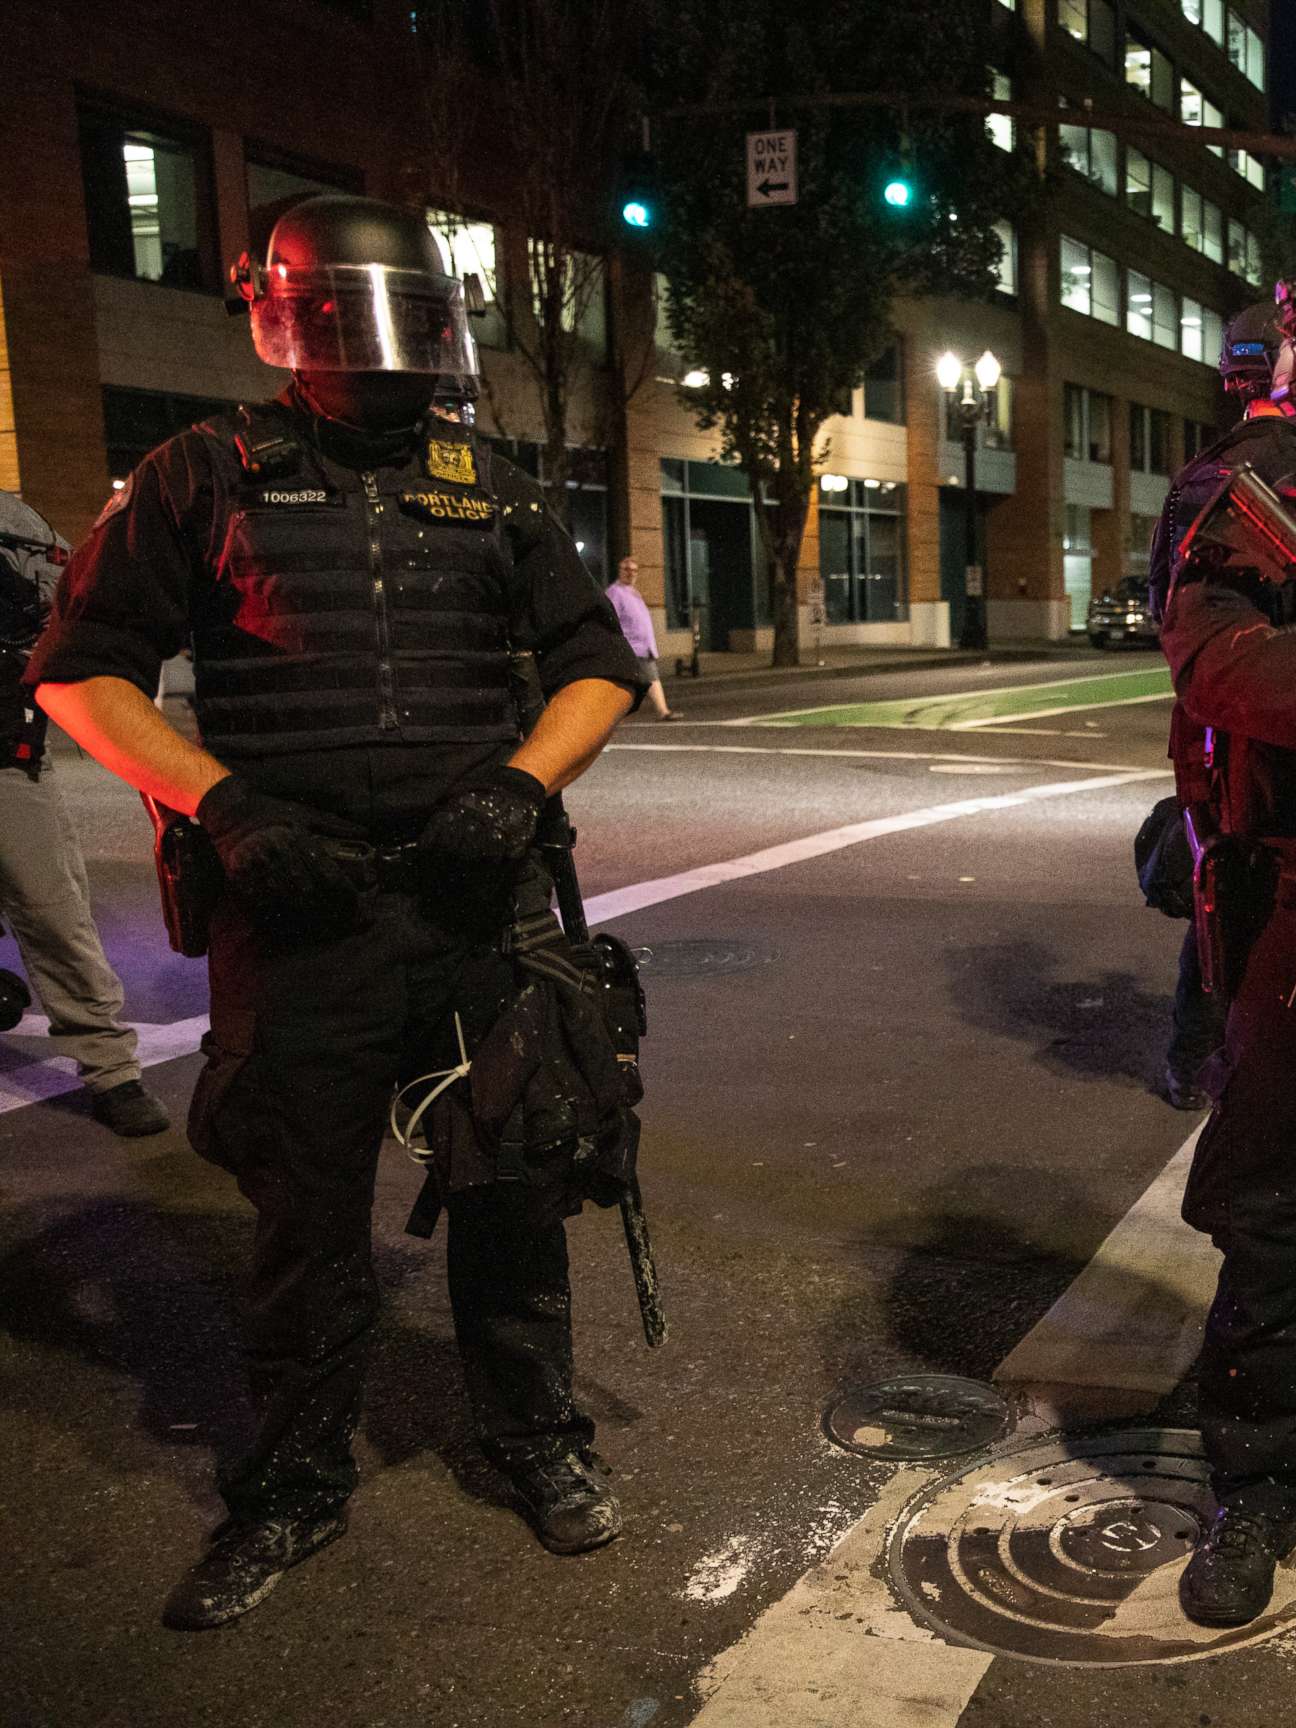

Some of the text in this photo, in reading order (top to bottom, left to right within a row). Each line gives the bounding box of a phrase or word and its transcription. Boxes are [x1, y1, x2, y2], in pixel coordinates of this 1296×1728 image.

[755, 136, 787, 155] ONE
[754, 156, 788, 173] WAY
[263, 490, 327, 504] 1006322
[430, 505, 493, 521] OLICE
